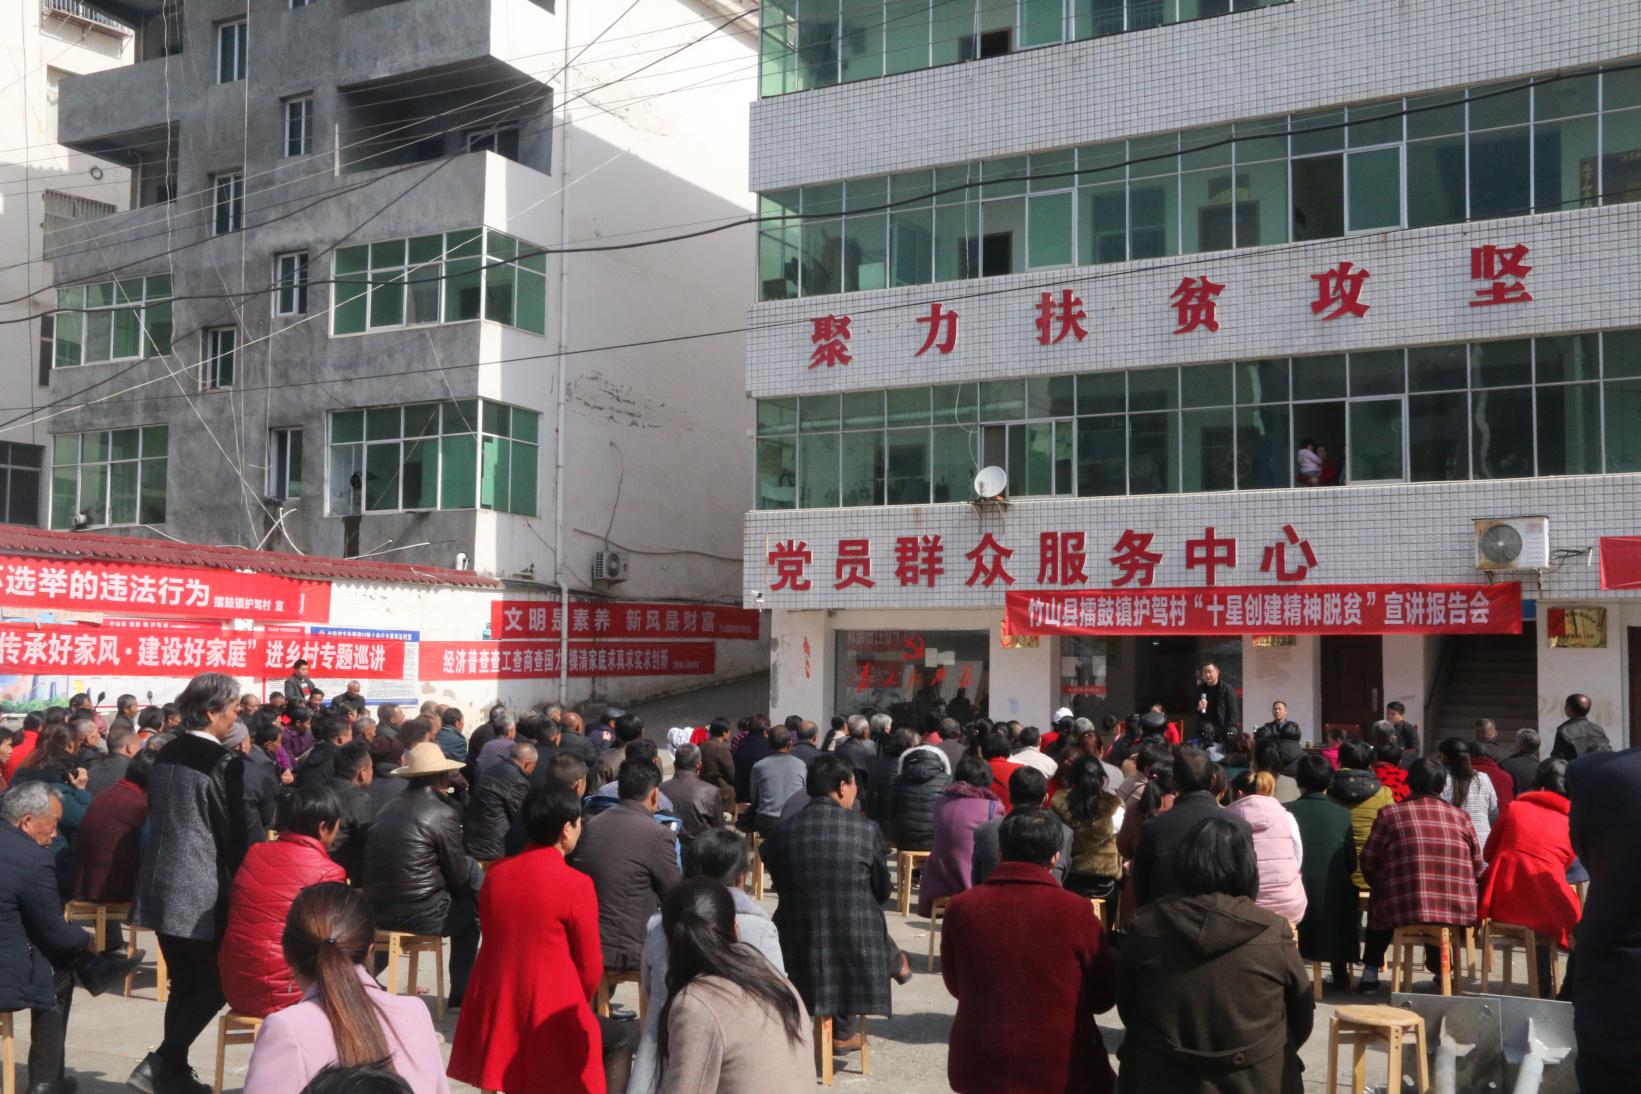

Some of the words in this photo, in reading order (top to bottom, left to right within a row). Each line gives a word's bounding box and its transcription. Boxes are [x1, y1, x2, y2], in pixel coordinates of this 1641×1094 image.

[809, 244, 1533, 368] 聚力扶贫攻坚
[768, 525, 1318, 591] 党员群众服务中心
